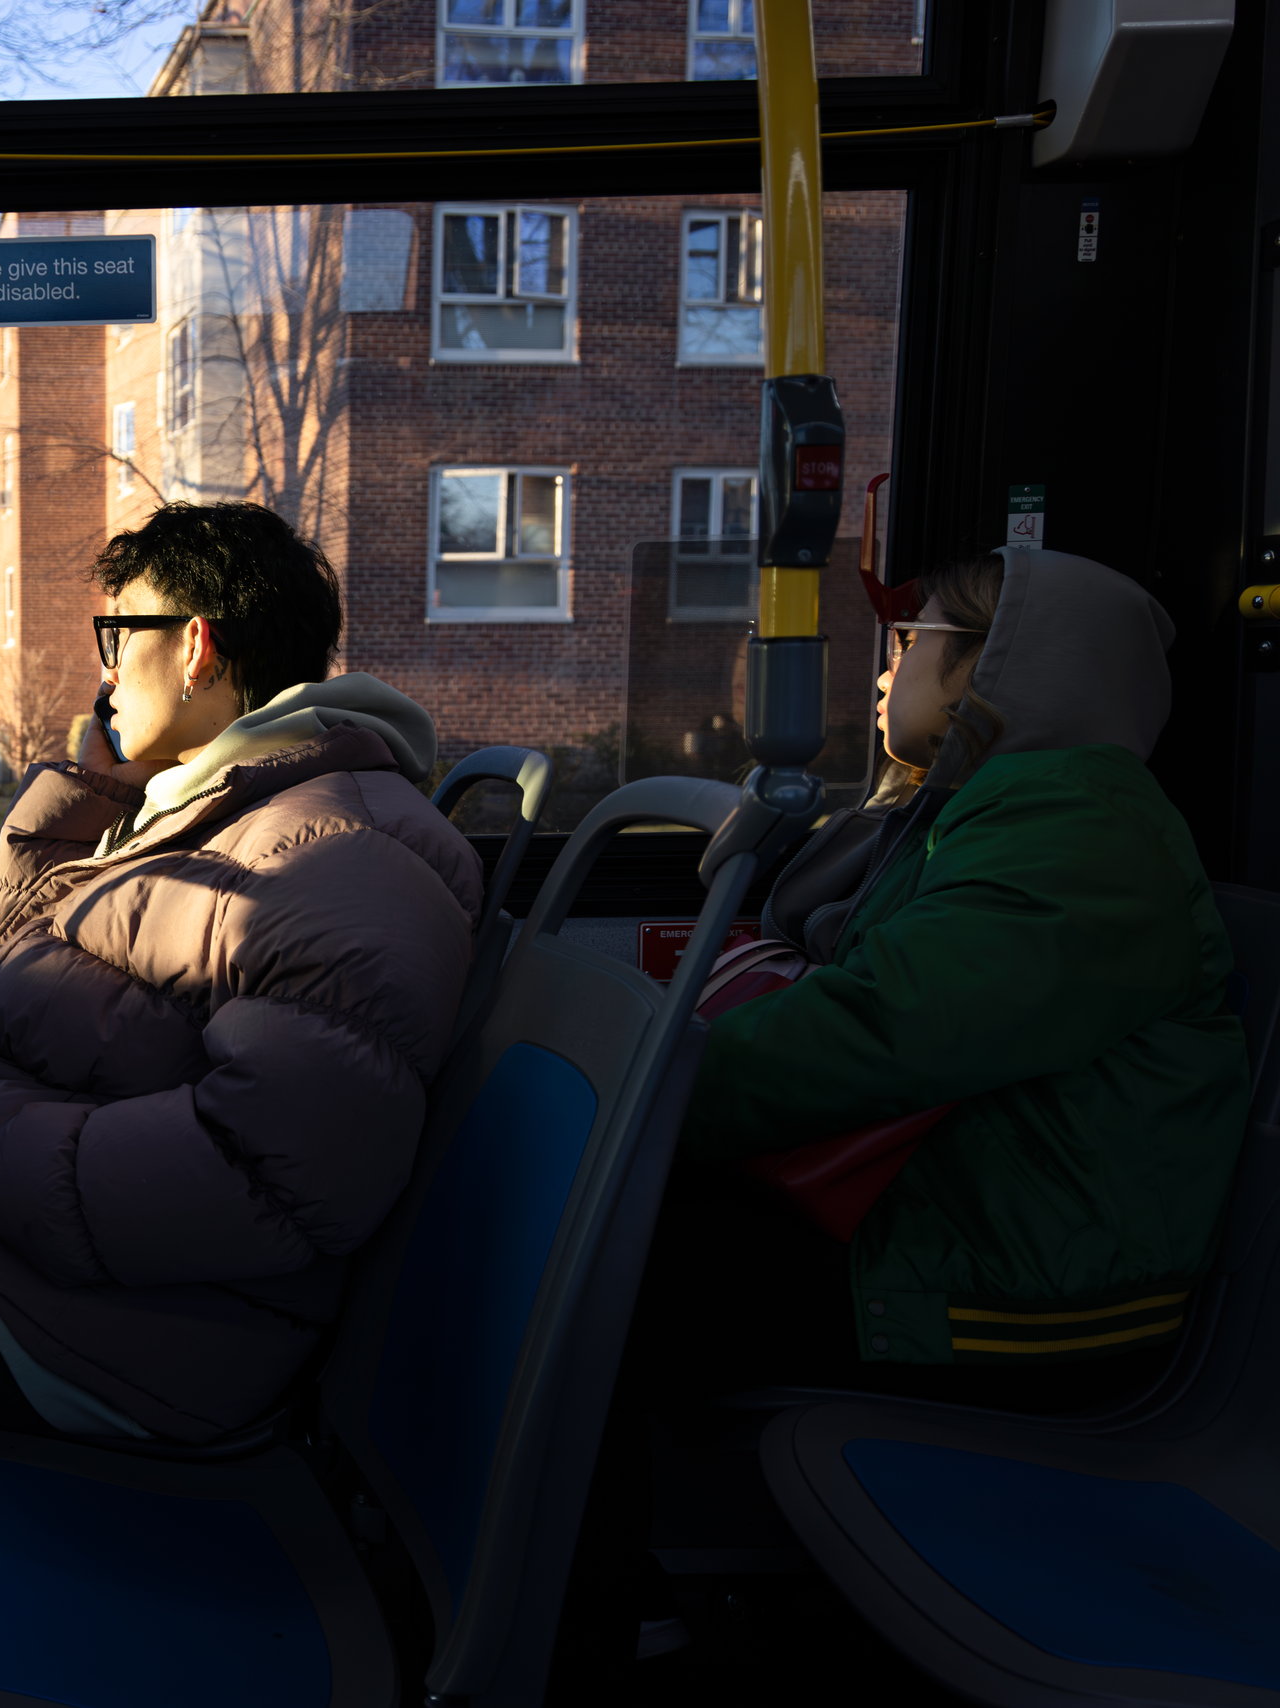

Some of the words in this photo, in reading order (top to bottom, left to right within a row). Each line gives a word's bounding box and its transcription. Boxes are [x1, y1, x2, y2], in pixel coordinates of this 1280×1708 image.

[8, 259, 48, 280] give
[52, 258, 88, 275] this
[93, 257, 135, 275] seat
[802, 461, 834, 474] STOP
